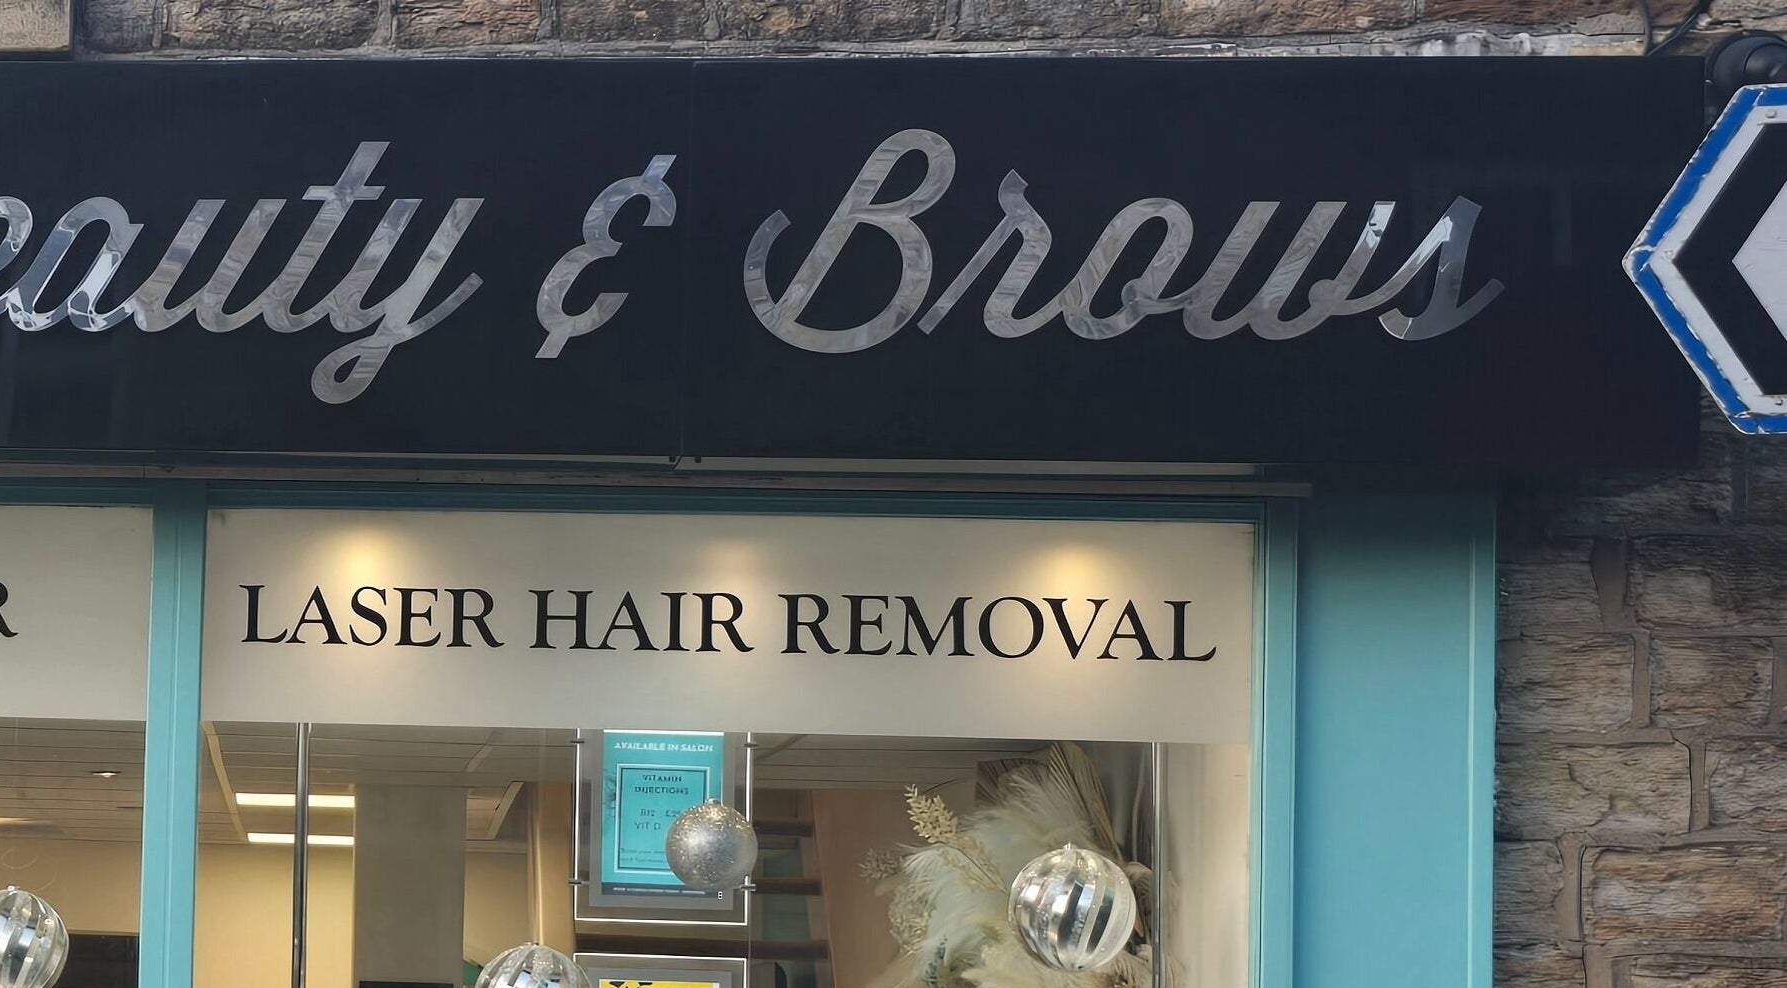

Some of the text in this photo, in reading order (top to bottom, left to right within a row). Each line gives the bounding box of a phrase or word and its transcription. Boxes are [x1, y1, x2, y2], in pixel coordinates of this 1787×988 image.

[535, 154, 677, 358] &
[743, 129, 1505, 354] Brows
[238, 585, 1217, 663] LASER HAIR REMOVAL
[614, 742, 713, 752] AVAILABLE IN SALON
[642, 774, 682, 782] VITAMIN
[634, 786, 689, 795] INJECTIONS
